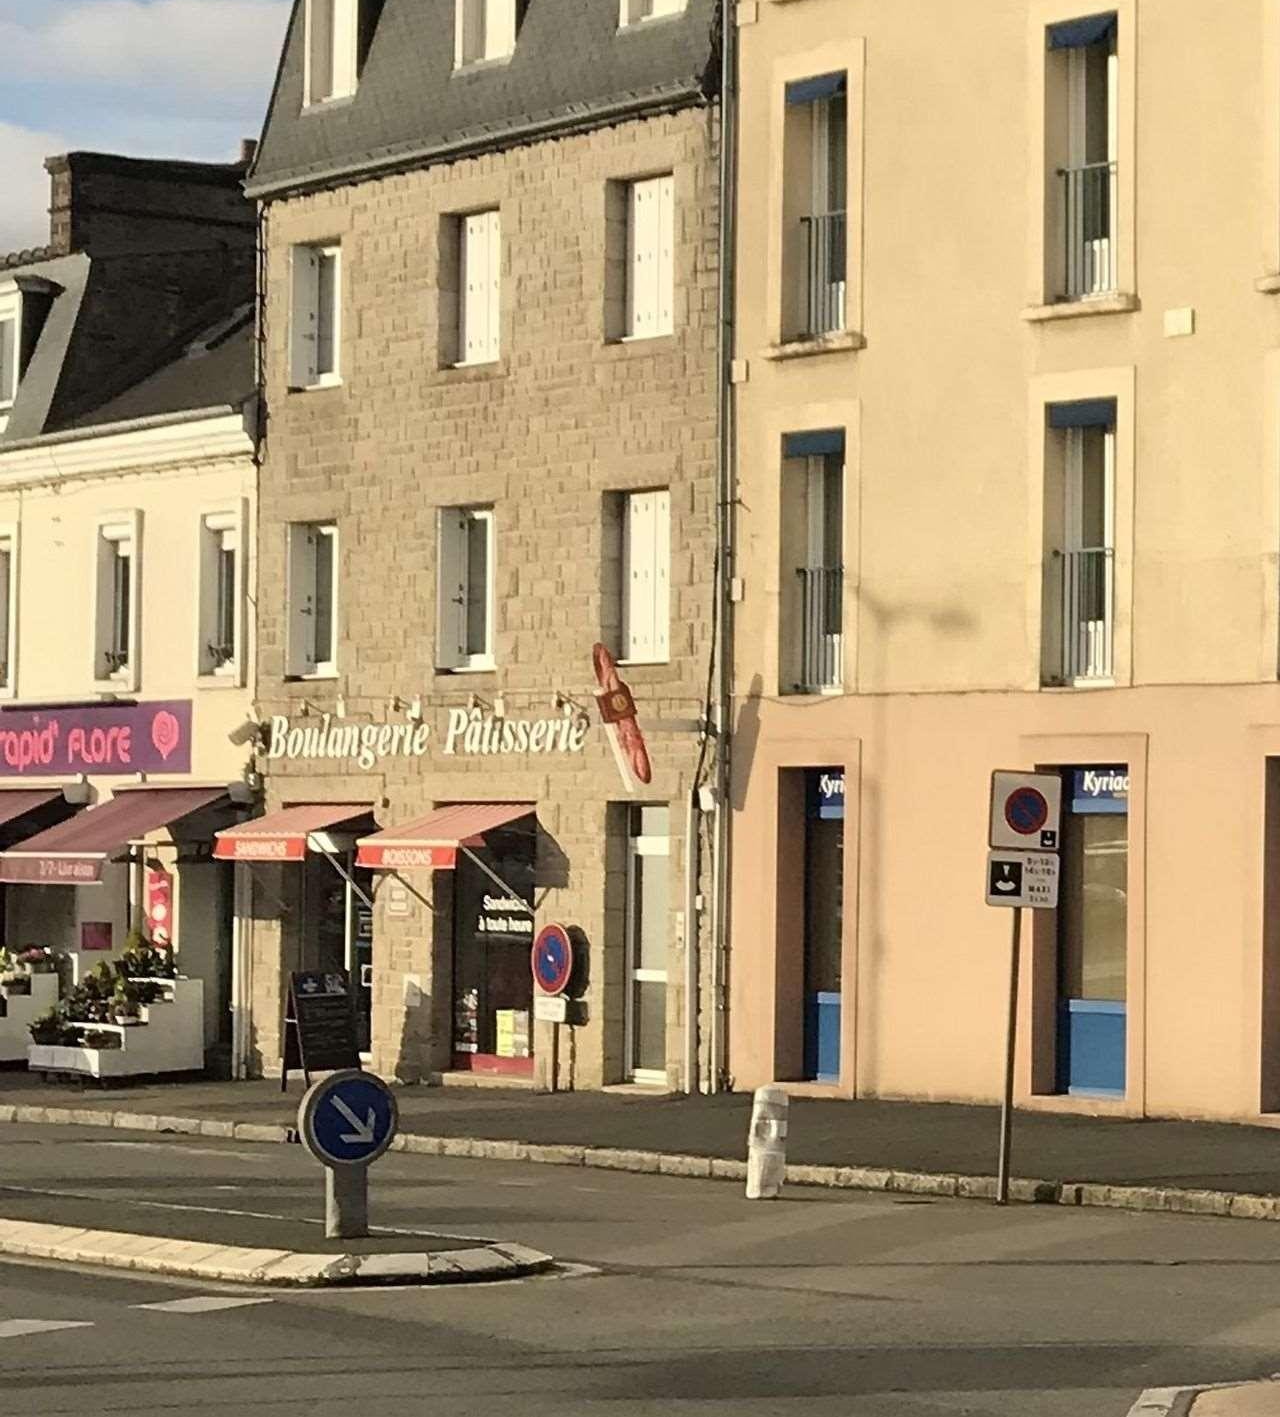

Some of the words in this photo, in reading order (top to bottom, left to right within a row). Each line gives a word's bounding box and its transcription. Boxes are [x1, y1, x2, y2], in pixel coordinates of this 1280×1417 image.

[268, 715, 430, 770] Boulangerie
[443, 707, 588, 755] Pâtisserie
[818, 774, 845, 798] Kyri
